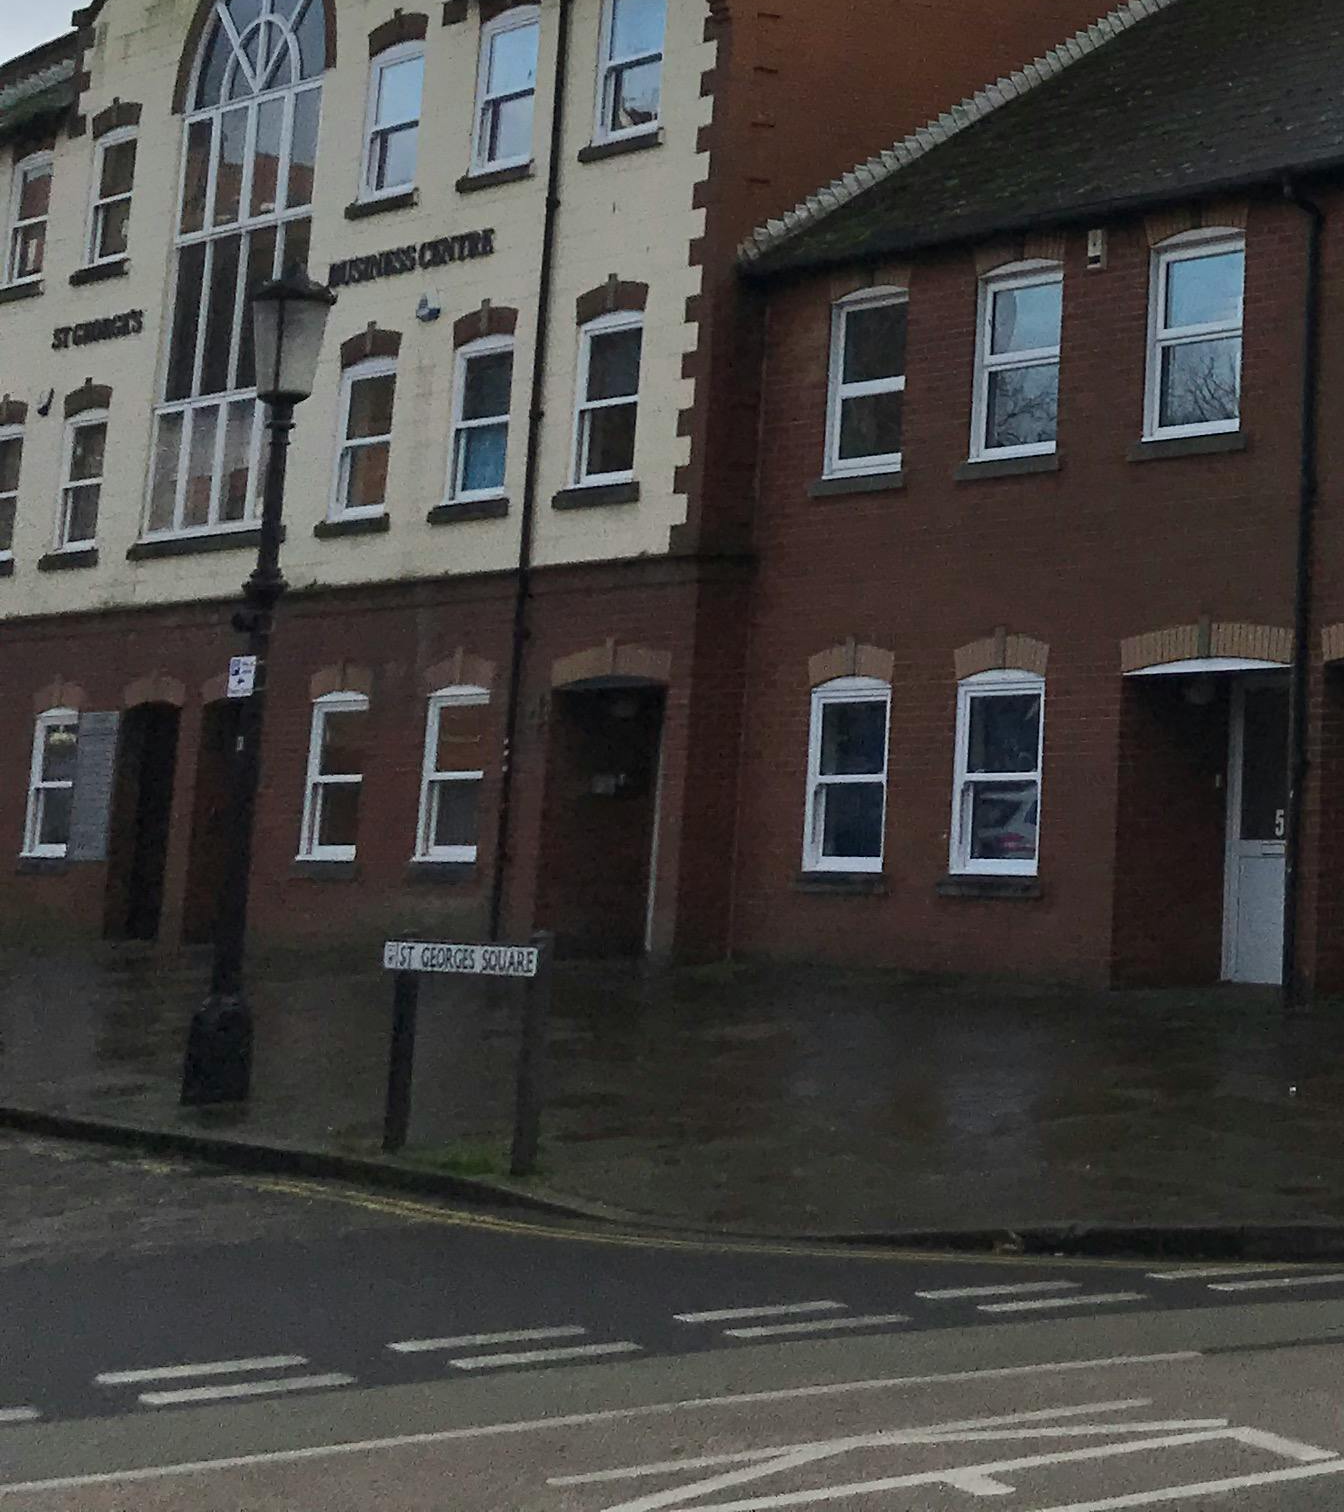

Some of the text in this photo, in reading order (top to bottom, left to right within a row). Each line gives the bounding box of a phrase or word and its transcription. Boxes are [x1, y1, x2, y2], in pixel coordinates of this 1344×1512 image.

[327, 228, 495, 288] BUSINESS CENTRE
[1275, 809, 1285, 836] 5
[400, 946, 534, 972] ST GEORGES SQUARE
